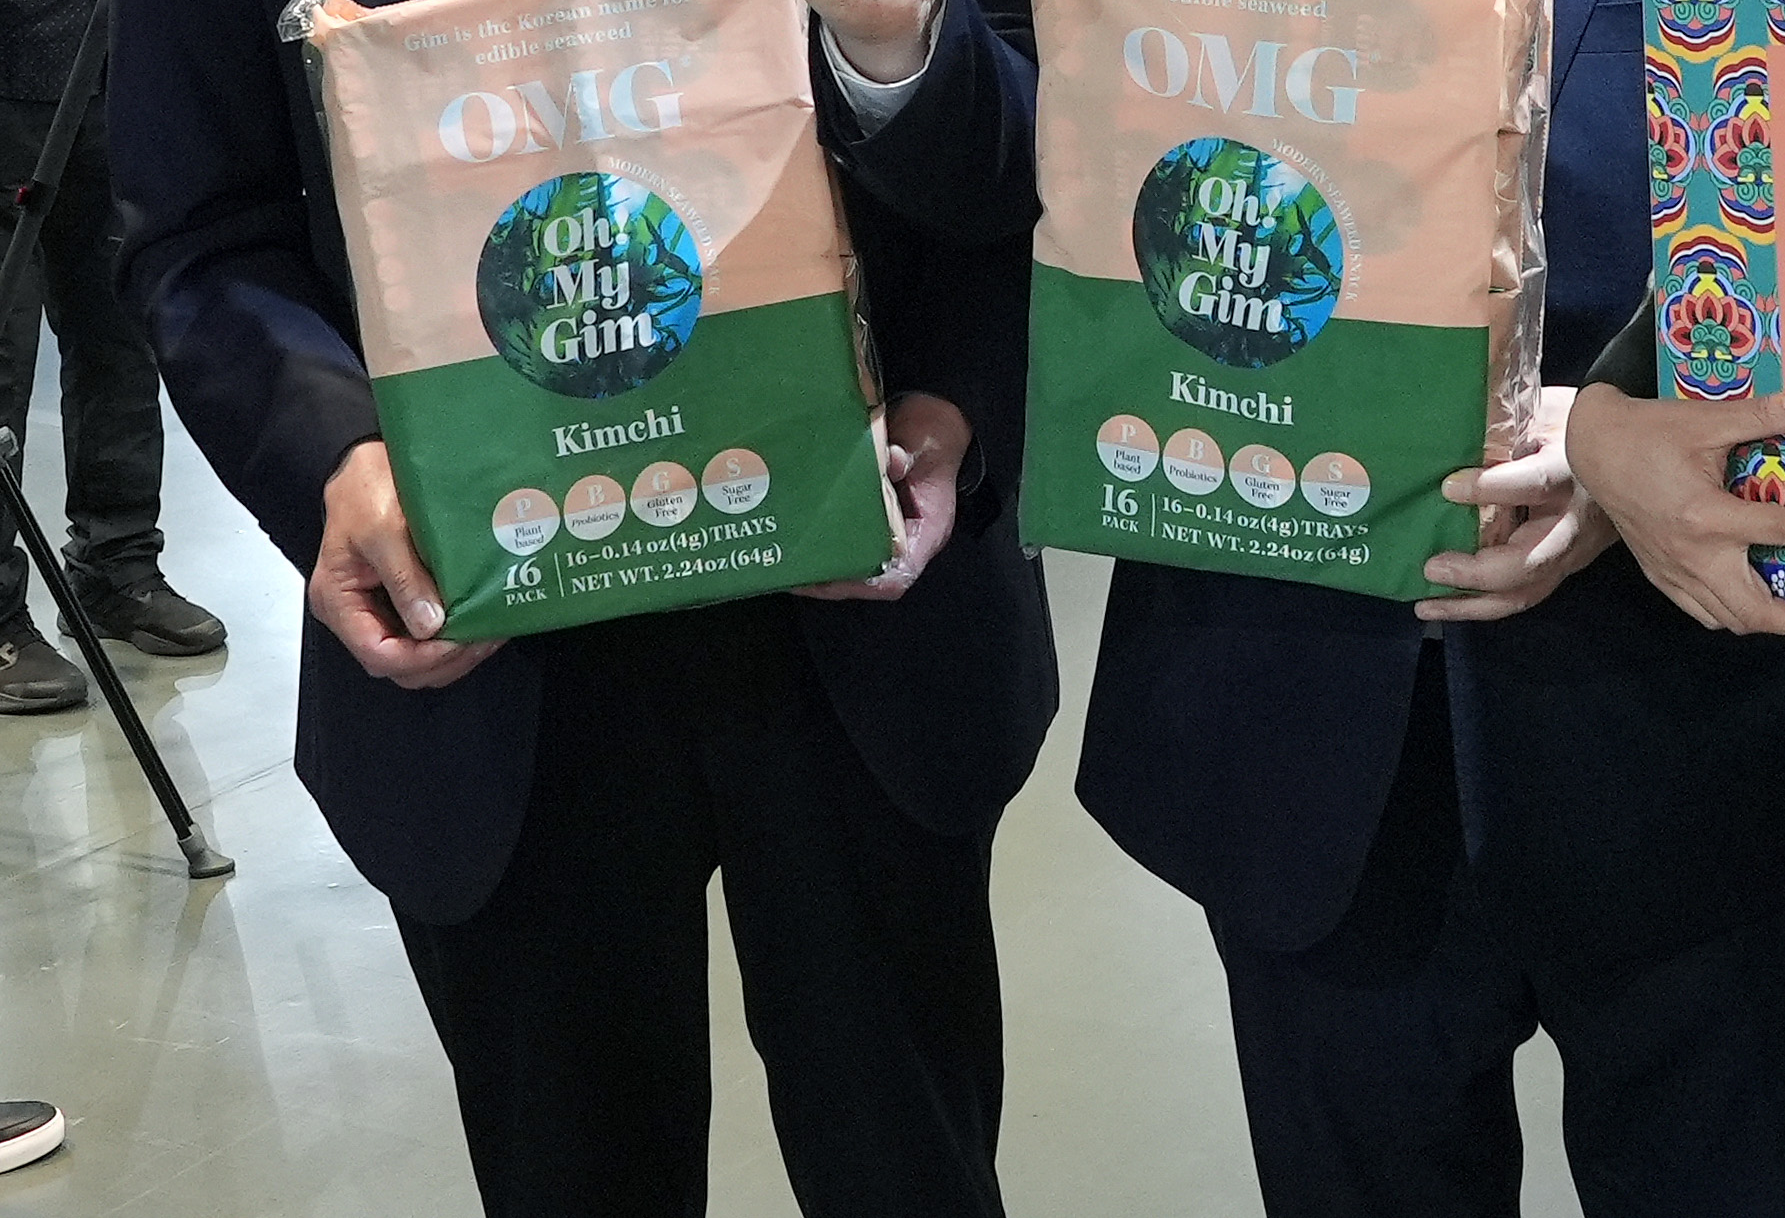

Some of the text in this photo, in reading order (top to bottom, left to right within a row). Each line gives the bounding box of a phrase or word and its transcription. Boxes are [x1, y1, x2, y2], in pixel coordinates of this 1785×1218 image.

[404, 33, 449, 52] Gim
[454, 26, 471, 42] is
[478, 20, 512, 40] the
[518, 6, 591, 30] Korean
[475, 22, 632, 65] edible seaweed
[1123, 27, 1365, 124] OMG
[438, 62, 684, 163] OMG
[1200, 177, 1282, 229] Oh!
[544, 207, 629, 257] Oh!
[1192, 221, 1270, 288] My
[547, 259, 629, 310] My
[1179, 271, 1283, 333] Gim
[541, 309, 656, 363] Gim
[1169, 371, 1294, 425] Kimchi
[552, 405, 685, 457] Kimchi
[1113, 459, 1141, 475] based
[1115, 449, 1140, 463] Plant
[1169, 465, 1218, 483] Probiotics
[1245, 477, 1279, 491] Gluten
[1101, 484, 1139, 516] 16
[1251, 488, 1273, 500] Free
[1320, 487, 1351, 498] Sugar
[1324, 497, 1348, 508] Free
[1102, 515, 1139, 532] PACK
[1162, 523, 1201, 544] NET
[1207, 532, 1244, 552] WT.
[1301, 520, 1369, 539] TRAYS
[502, 556, 542, 590] 16
[505, 588, 547, 606] PACK
